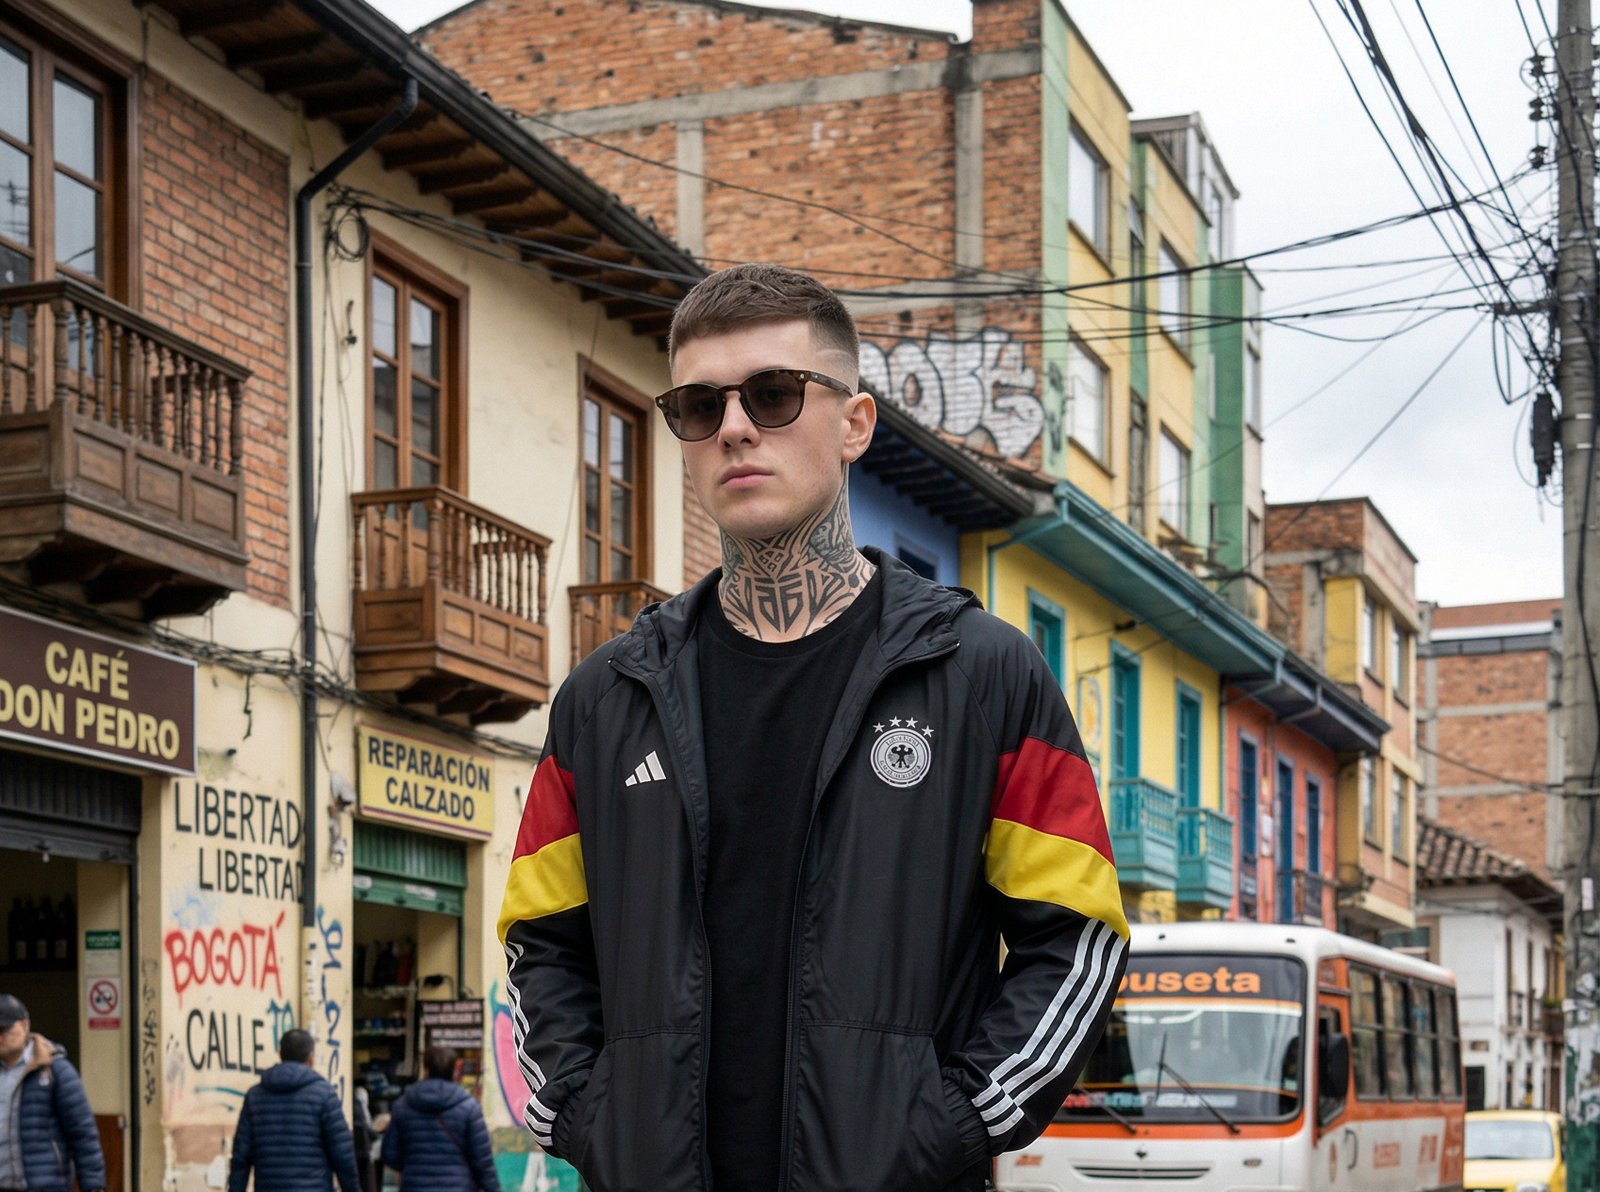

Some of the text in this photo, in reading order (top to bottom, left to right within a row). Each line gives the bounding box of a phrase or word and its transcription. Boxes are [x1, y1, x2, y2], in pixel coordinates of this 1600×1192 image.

[45, 641, 129, 700] CAFÉ
[75, 697, 180, 760] PEDRO
[368, 736, 490, 793] REPARACIÓN
[175, 782, 302, 849] LIBERTAD
[386, 776, 474, 821] CALZADO
[164, 910, 285, 1000] BOGOTÁ
[187, 1008, 266, 1076] CALLE
